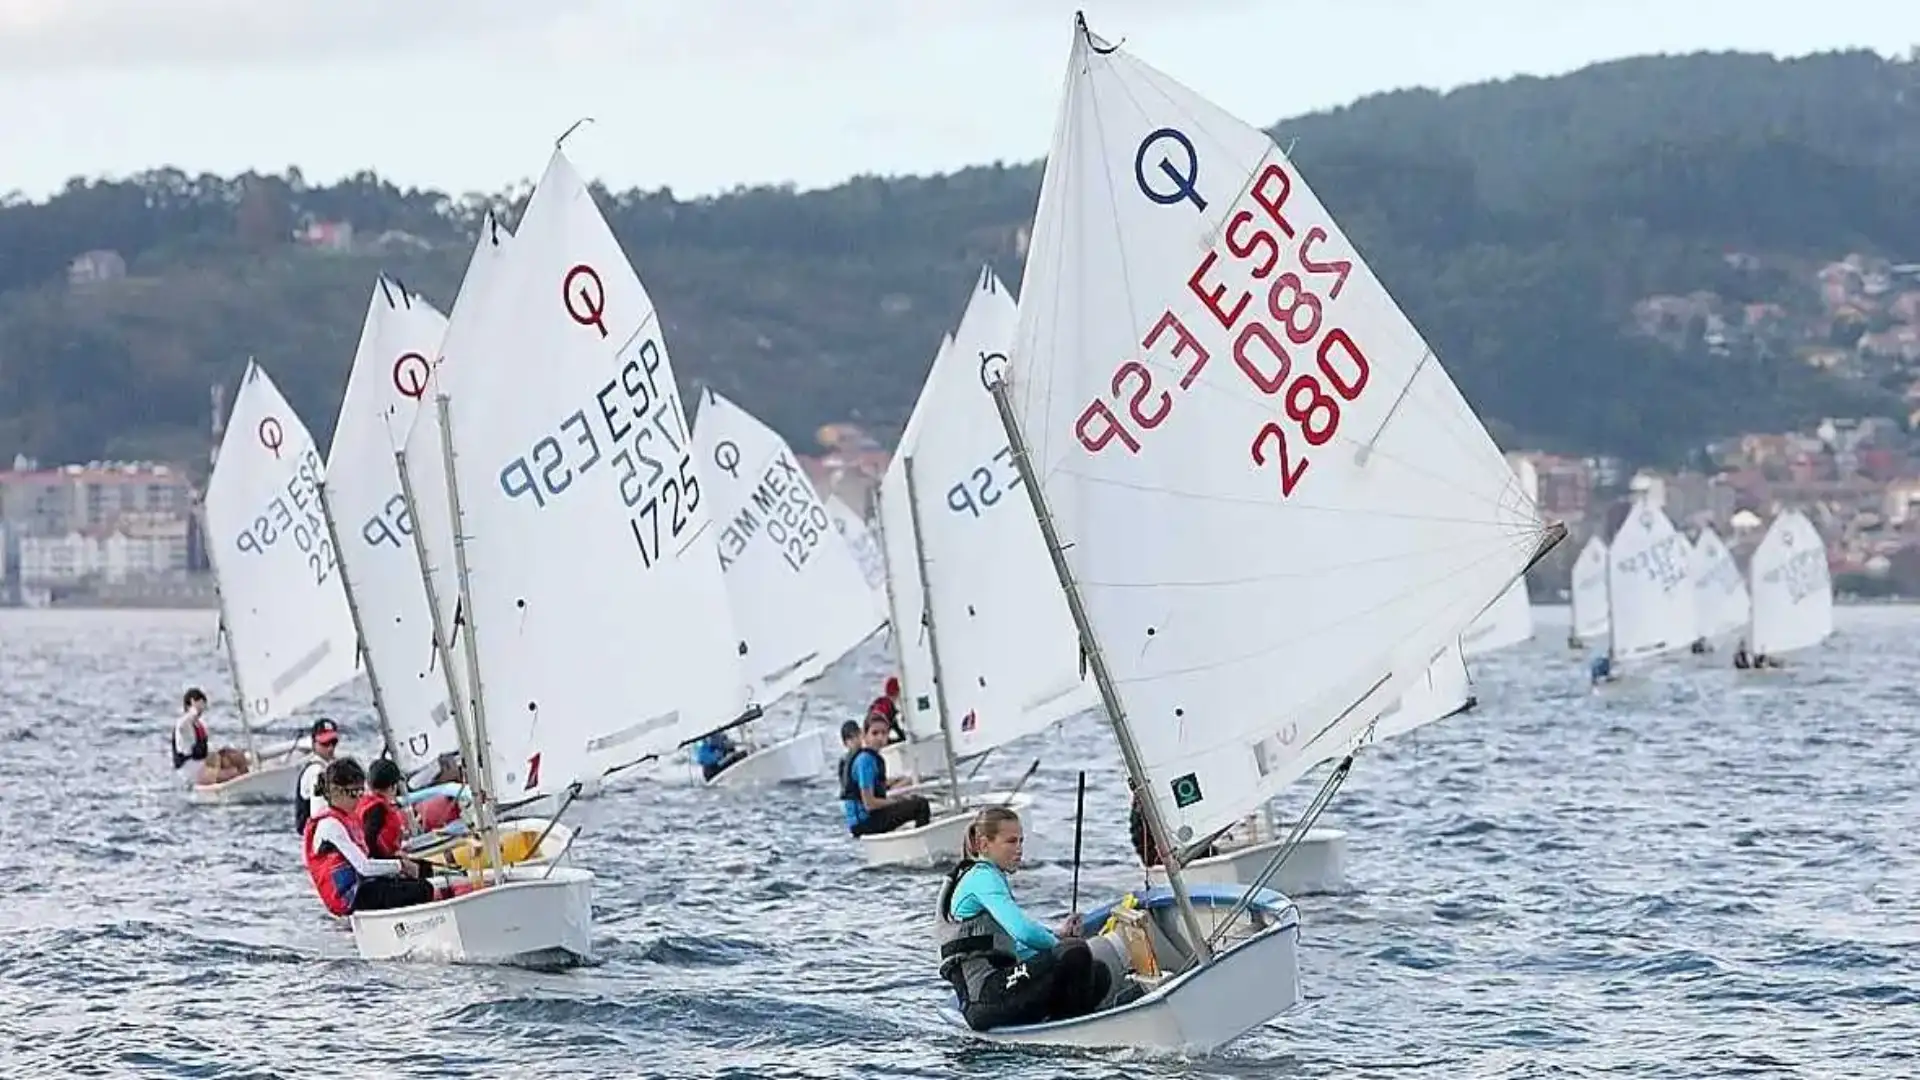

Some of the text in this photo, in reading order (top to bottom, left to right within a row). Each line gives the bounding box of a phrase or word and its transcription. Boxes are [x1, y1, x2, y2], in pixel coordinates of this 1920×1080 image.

[1187, 164, 1296, 330] ESP
[596, 338, 660, 443] ESP
[1251, 328, 1370, 498] 280
[287, 450, 321, 511] ESP
[630, 453, 700, 569] 1725
[751, 451, 798, 515] MEX
[782, 505, 829, 572] 1250
